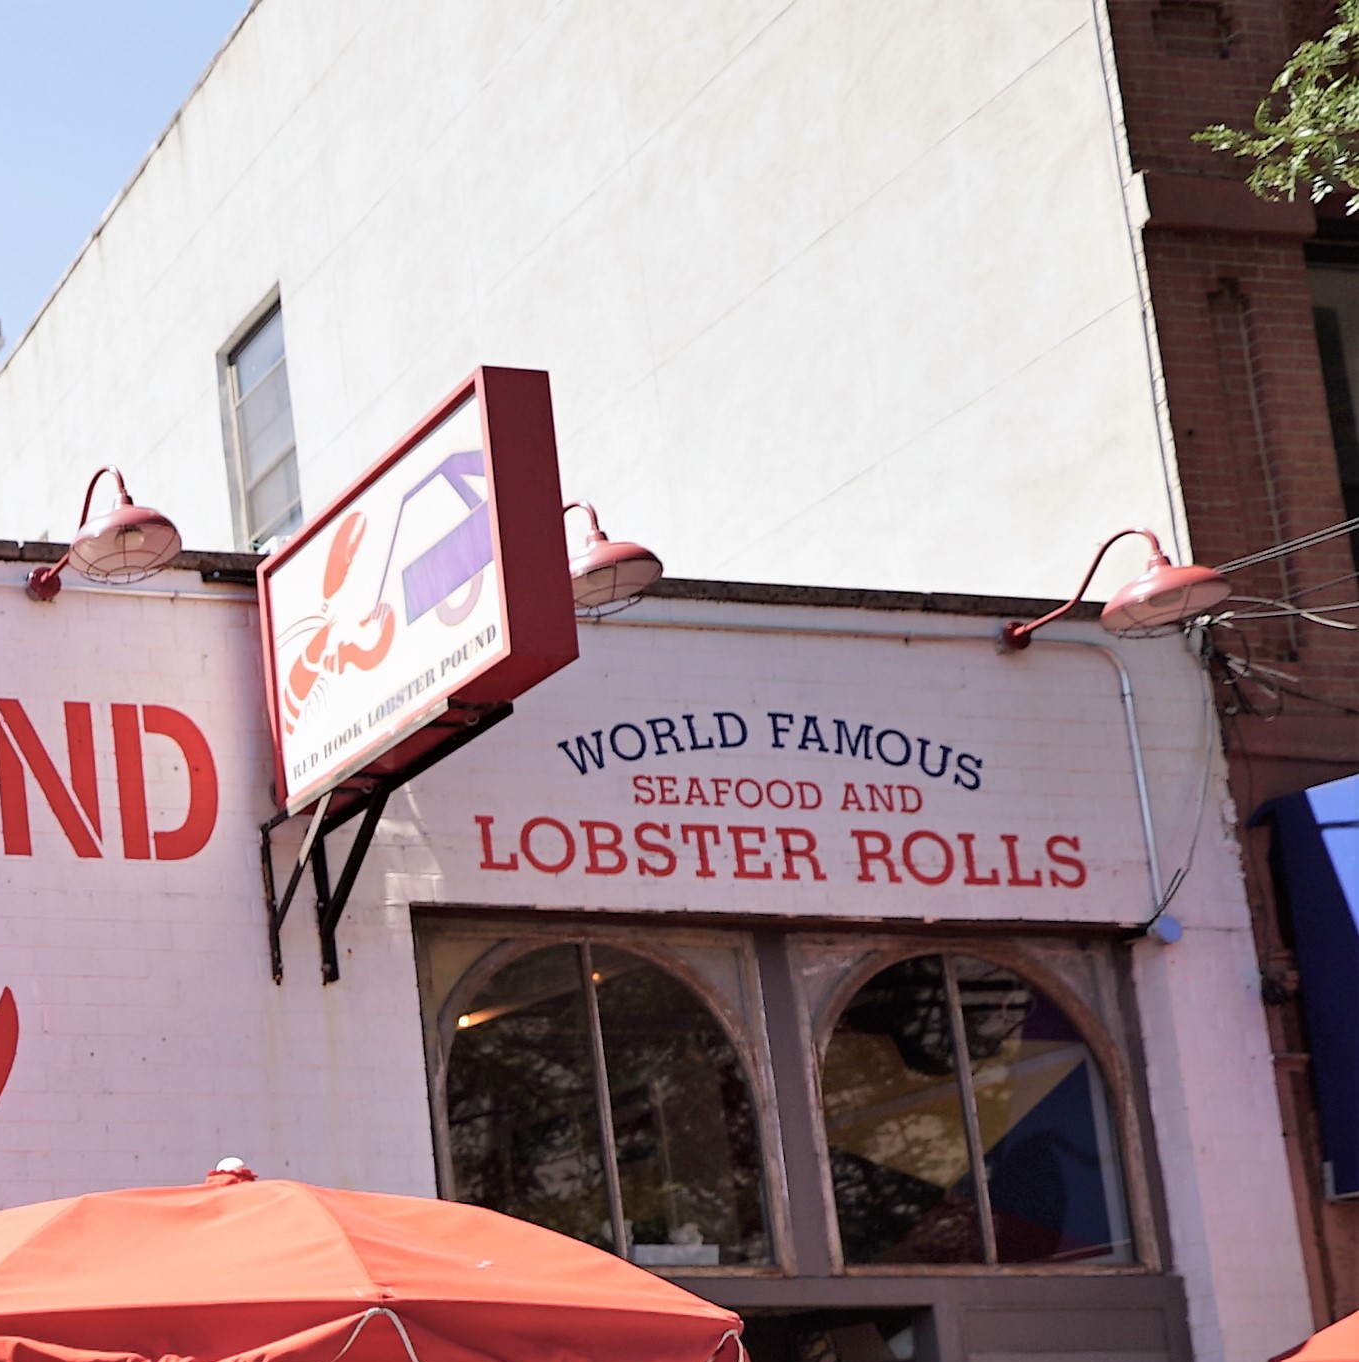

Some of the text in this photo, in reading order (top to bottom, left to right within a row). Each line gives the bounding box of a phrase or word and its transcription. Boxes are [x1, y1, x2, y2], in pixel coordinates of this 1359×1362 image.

[293, 624, 496, 780] RED HOOK LOBSTER POUND
[558, 712, 984, 791] WORLD FAMOUS
[633, 774, 924, 814] SEAFOOD AND
[474, 814, 1087, 889] LOBSTER ROLLS
